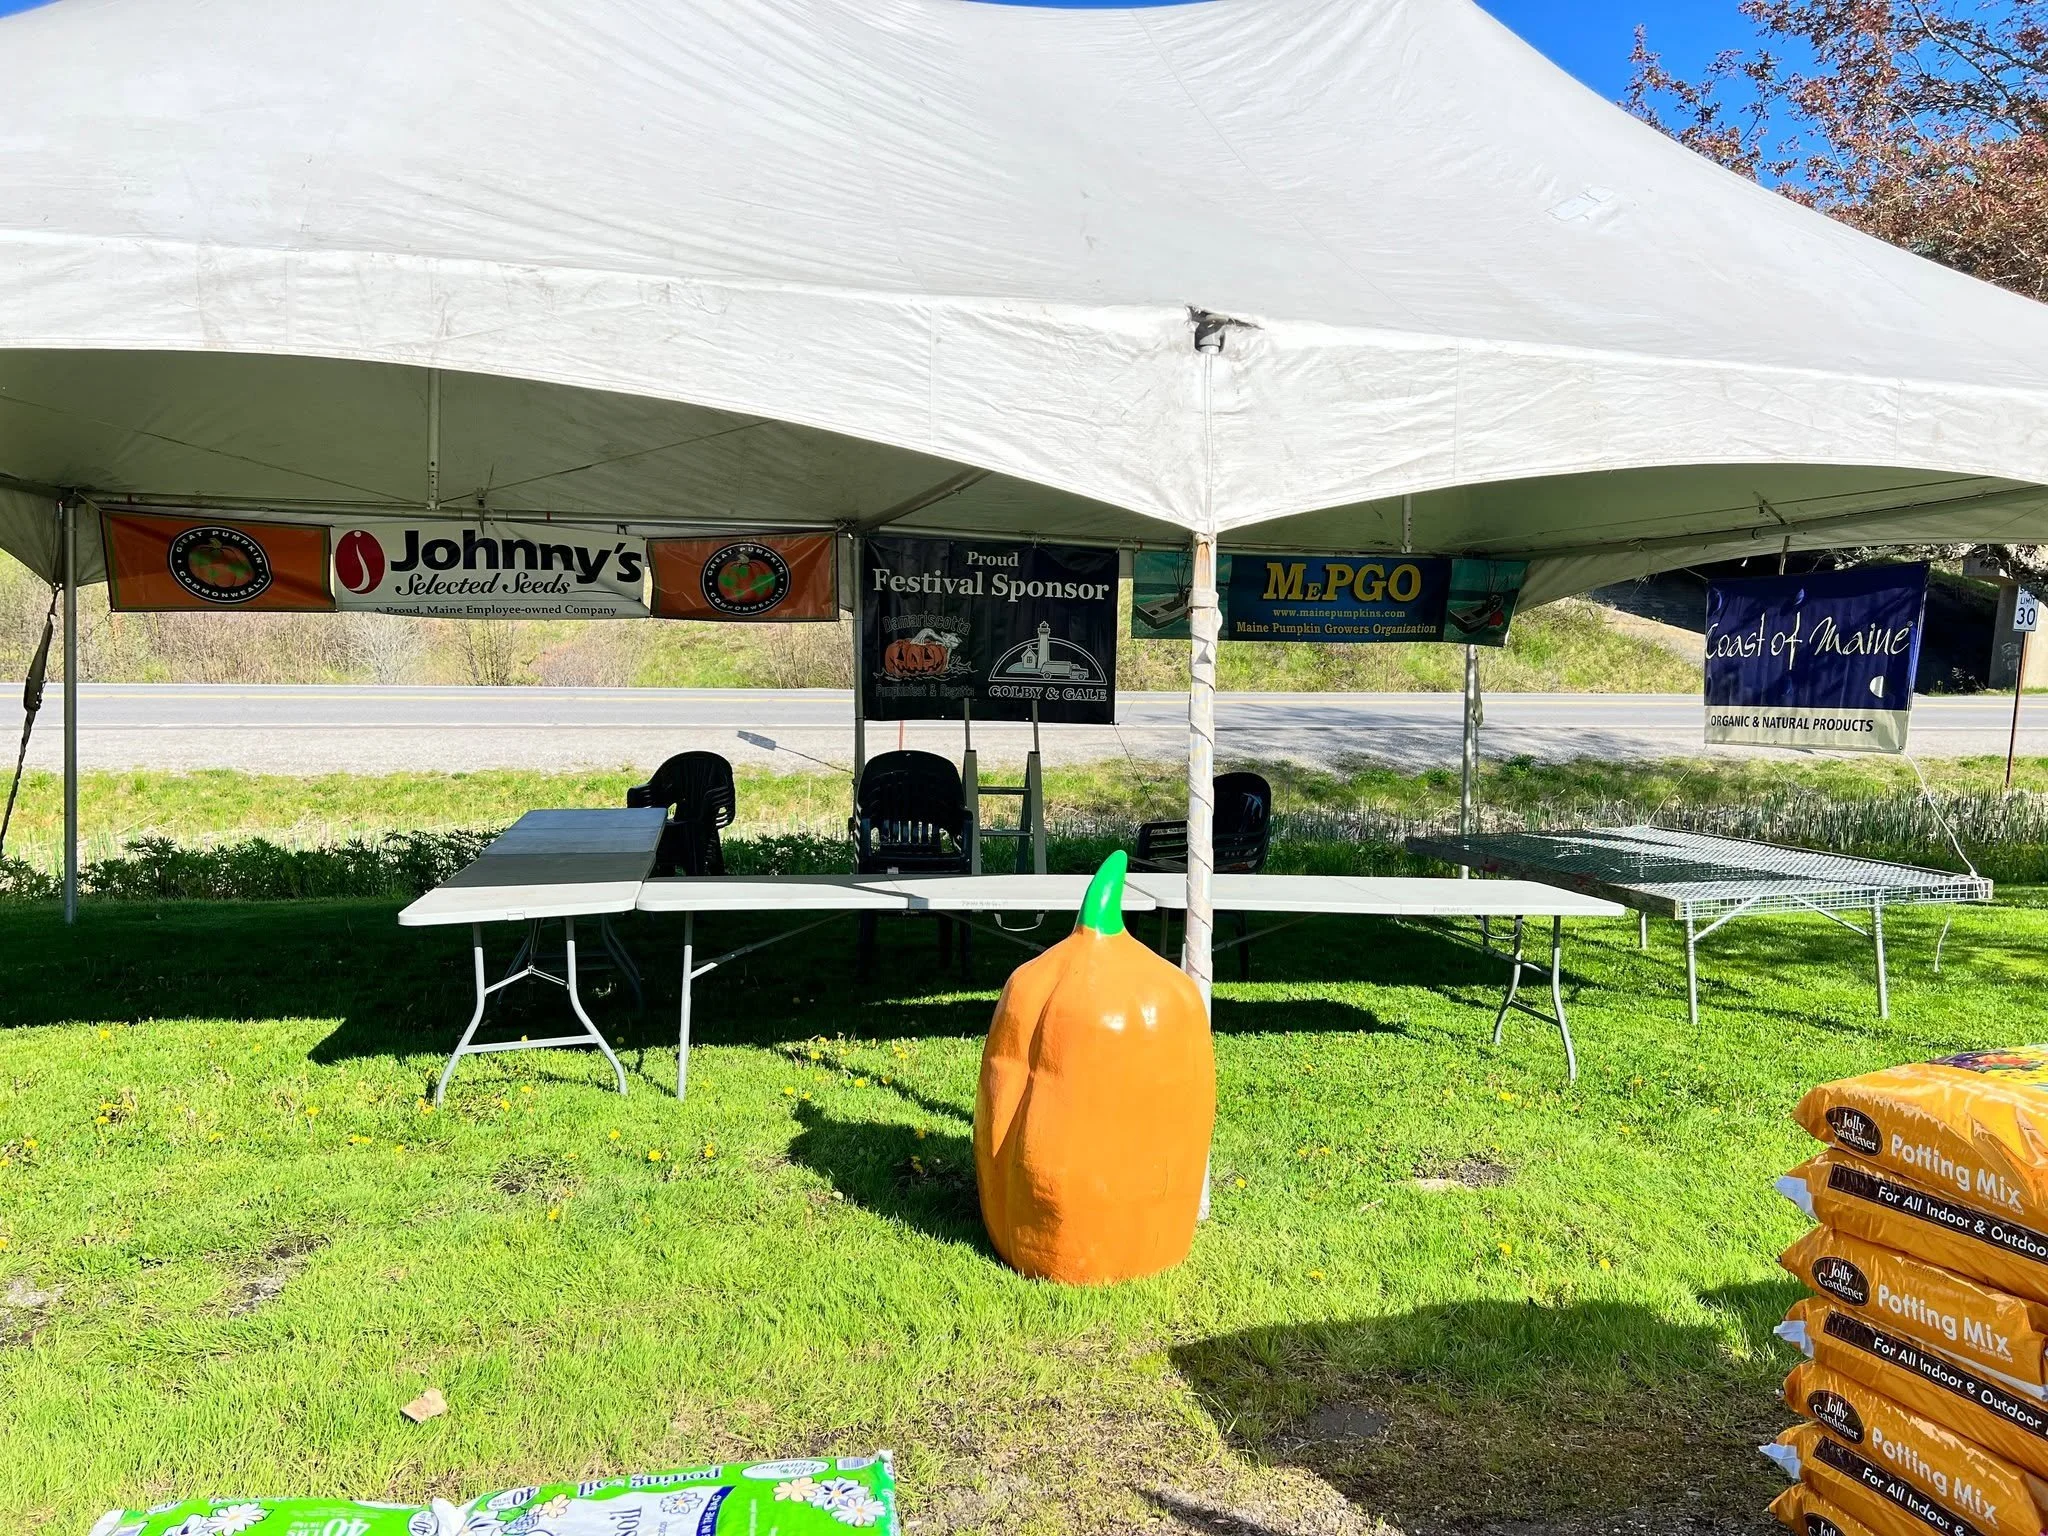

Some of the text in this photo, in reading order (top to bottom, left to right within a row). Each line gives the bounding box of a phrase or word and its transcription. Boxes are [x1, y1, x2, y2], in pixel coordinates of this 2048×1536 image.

[175, 530, 263, 564] GEAT PUMPKIN
[390, 529, 643, 585] Johnny's
[966, 551, 1019, 567] Proud
[708, 546, 785, 576] GREAT PUMPKIN
[180, 570, 266, 598] COMMONWEALT
[395, 571, 571, 596] Selected Seeds
[873, 568, 1110, 603] Festival Sponsor
[386, 605, 424, 615] Proud,
[427, 605, 463, 614] Maine
[466, 604, 562, 617] Employee-owned
[565, 605, 617, 617] Company
[882, 611, 972, 636] Damariscotta
[1273, 608, 1406, 620] www.mainepumpkins.com
[2016, 607, 2036, 626] 30
[1236, 621, 1437, 637] Maine Pumpkin Growers Organization
[1705, 611, 1911, 671] Coast of Maine
[988, 685, 1108, 702] COLBY & GALE
[1711, 715, 1874, 732] ORGANIC & NATURAL PRODUCTS
[1842, 1111, 1866, 1136] Jolly
[1891, 1133, 1971, 1191] Potting
[1976, 1167, 2022, 1208] Mix
[1877, 1185, 1901, 1204] For
[1903, 1194, 1922, 1212] All
[1926, 1203, 1971, 1229] Indoor
[1974, 1219, 1986, 1235] &
[1991, 1226, 2048, 1258] Outdoo
[1818, 1271, 1864, 1301] Gardener
[1829, 1261, 1854, 1286] Jolly
[1878, 1284, 1958, 1341] Potting
[1963, 1316, 2012, 1357] Mix
[1873, 1336, 2042, 1429] For All Indoor & Outdoor
[1813, 1404, 1859, 1440] Gardener
[1825, 1396, 1848, 1422] Jolly
[632, 1467, 720, 1487] potting
[1872, 1426, 1948, 1497] Potting
[1953, 1476, 1998, 1525] Mix
[512, 1486, 537, 1505] 40
[1862, 1467, 1885, 1489] For
[1886, 1481, 1906, 1502] All
[1907, 1493, 1950, 1530] Indoor
[1954, 1525, 1965, 1536] &
